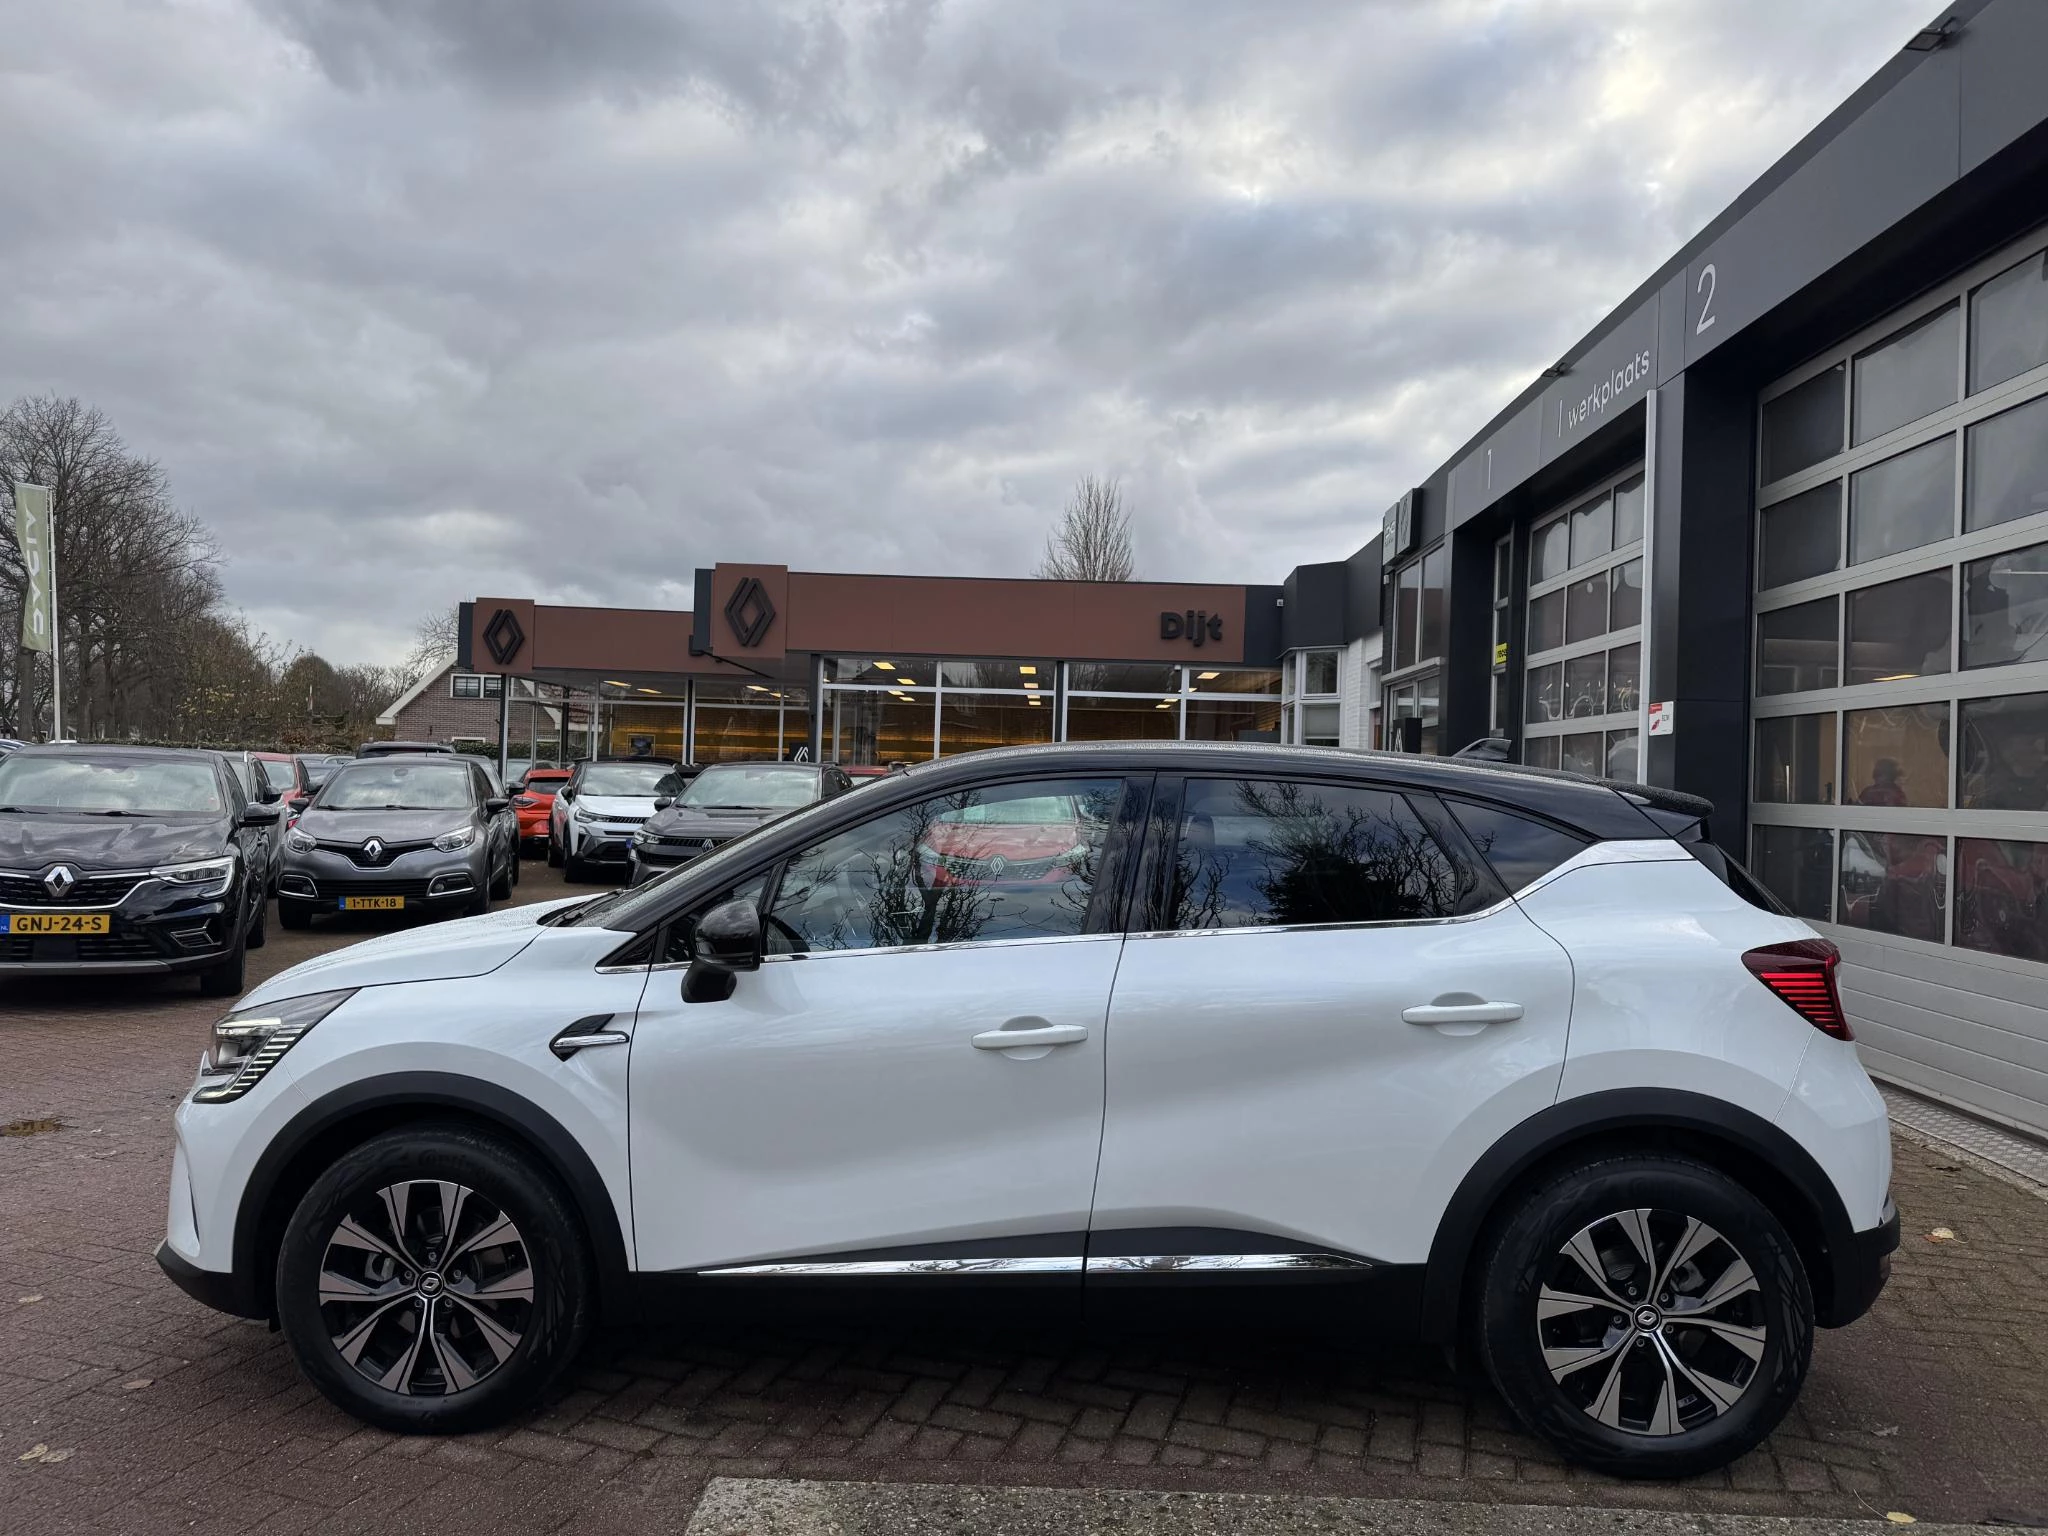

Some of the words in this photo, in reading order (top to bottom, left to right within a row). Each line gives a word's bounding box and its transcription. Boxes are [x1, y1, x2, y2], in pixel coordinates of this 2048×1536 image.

[1696, 263, 1716, 336] 2
[1487, 448, 1492, 490] 1
[1568, 350, 1650, 430] werkplaats
[1160, 610, 1223, 648] Dijt
[352, 898, 397, 908] 1-TTK-18
[16, 916, 103, 931] GNJ-24-S
